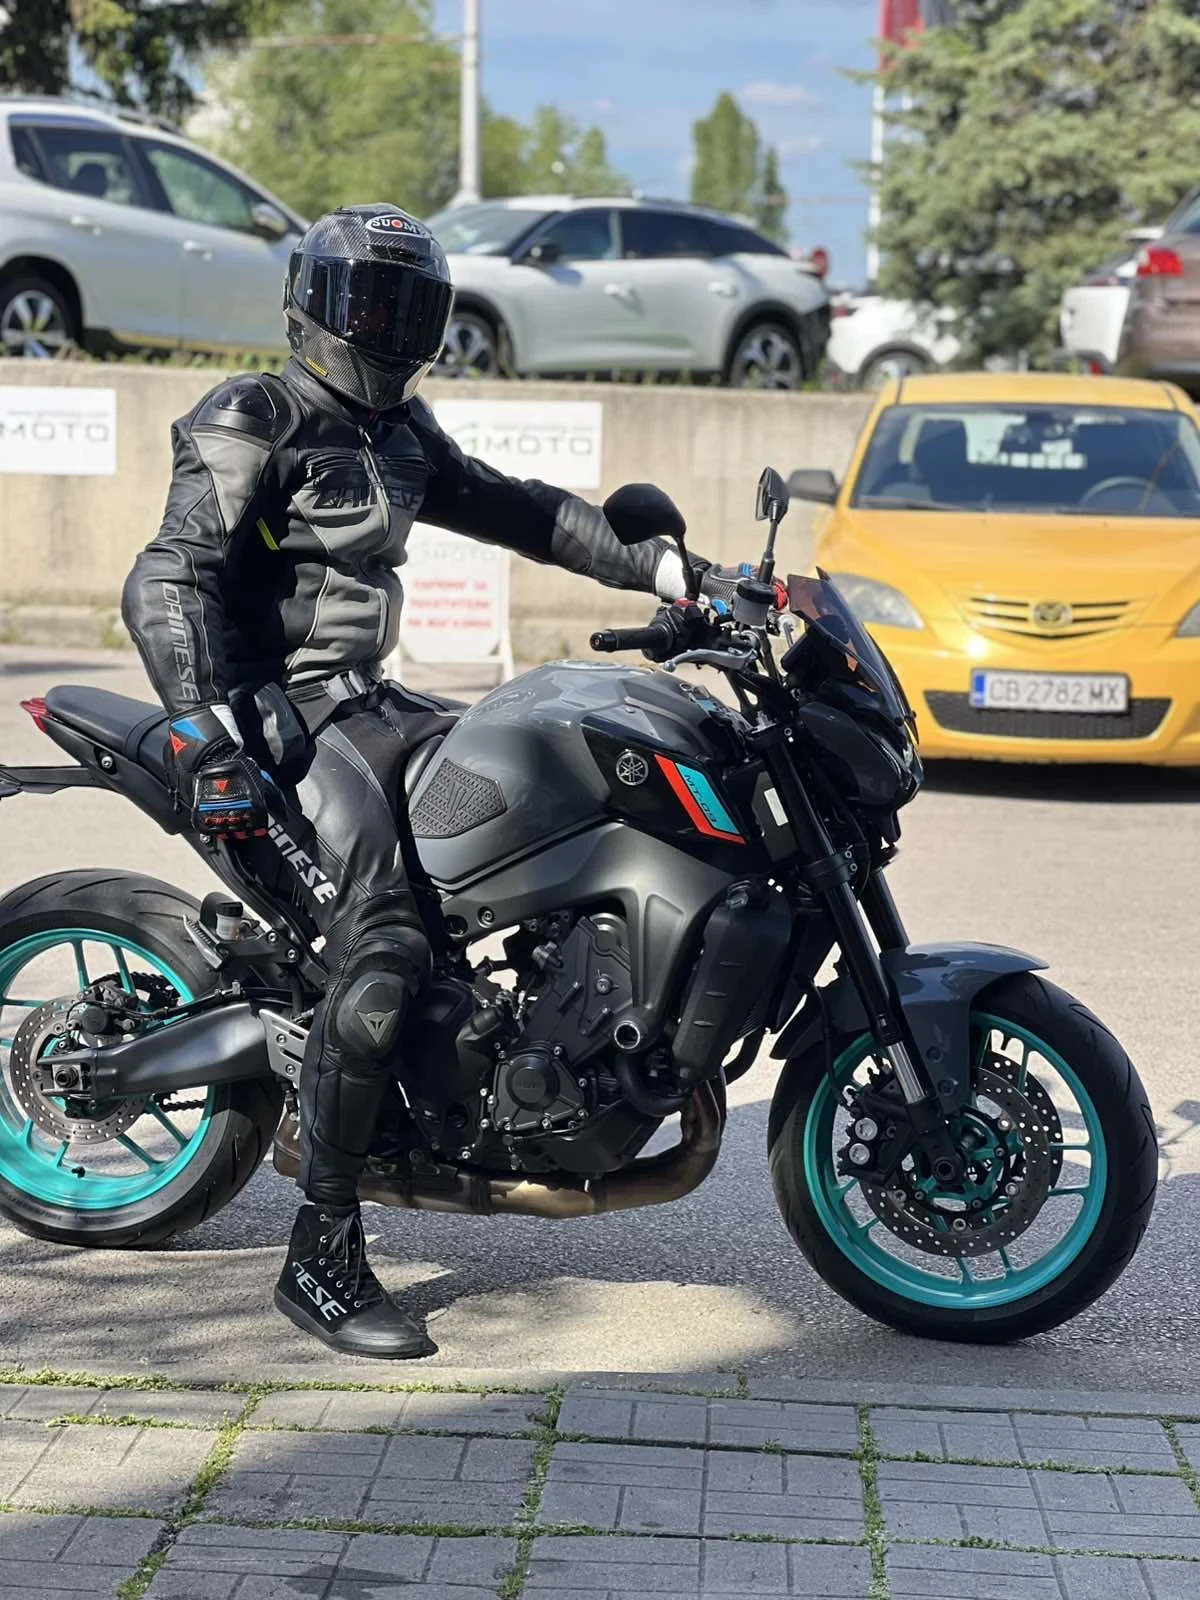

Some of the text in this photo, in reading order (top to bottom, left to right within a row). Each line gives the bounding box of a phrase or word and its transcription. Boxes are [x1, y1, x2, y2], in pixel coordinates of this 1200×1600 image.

[371, 218, 427, 237] SUOM
[485, 436, 594, 456] MOTO
[162, 581, 200, 701] DAINESE
[990, 679, 1019, 702] CB
[1025, 681, 1084, 705] 2782
[1089, 683, 1119, 705] MX
